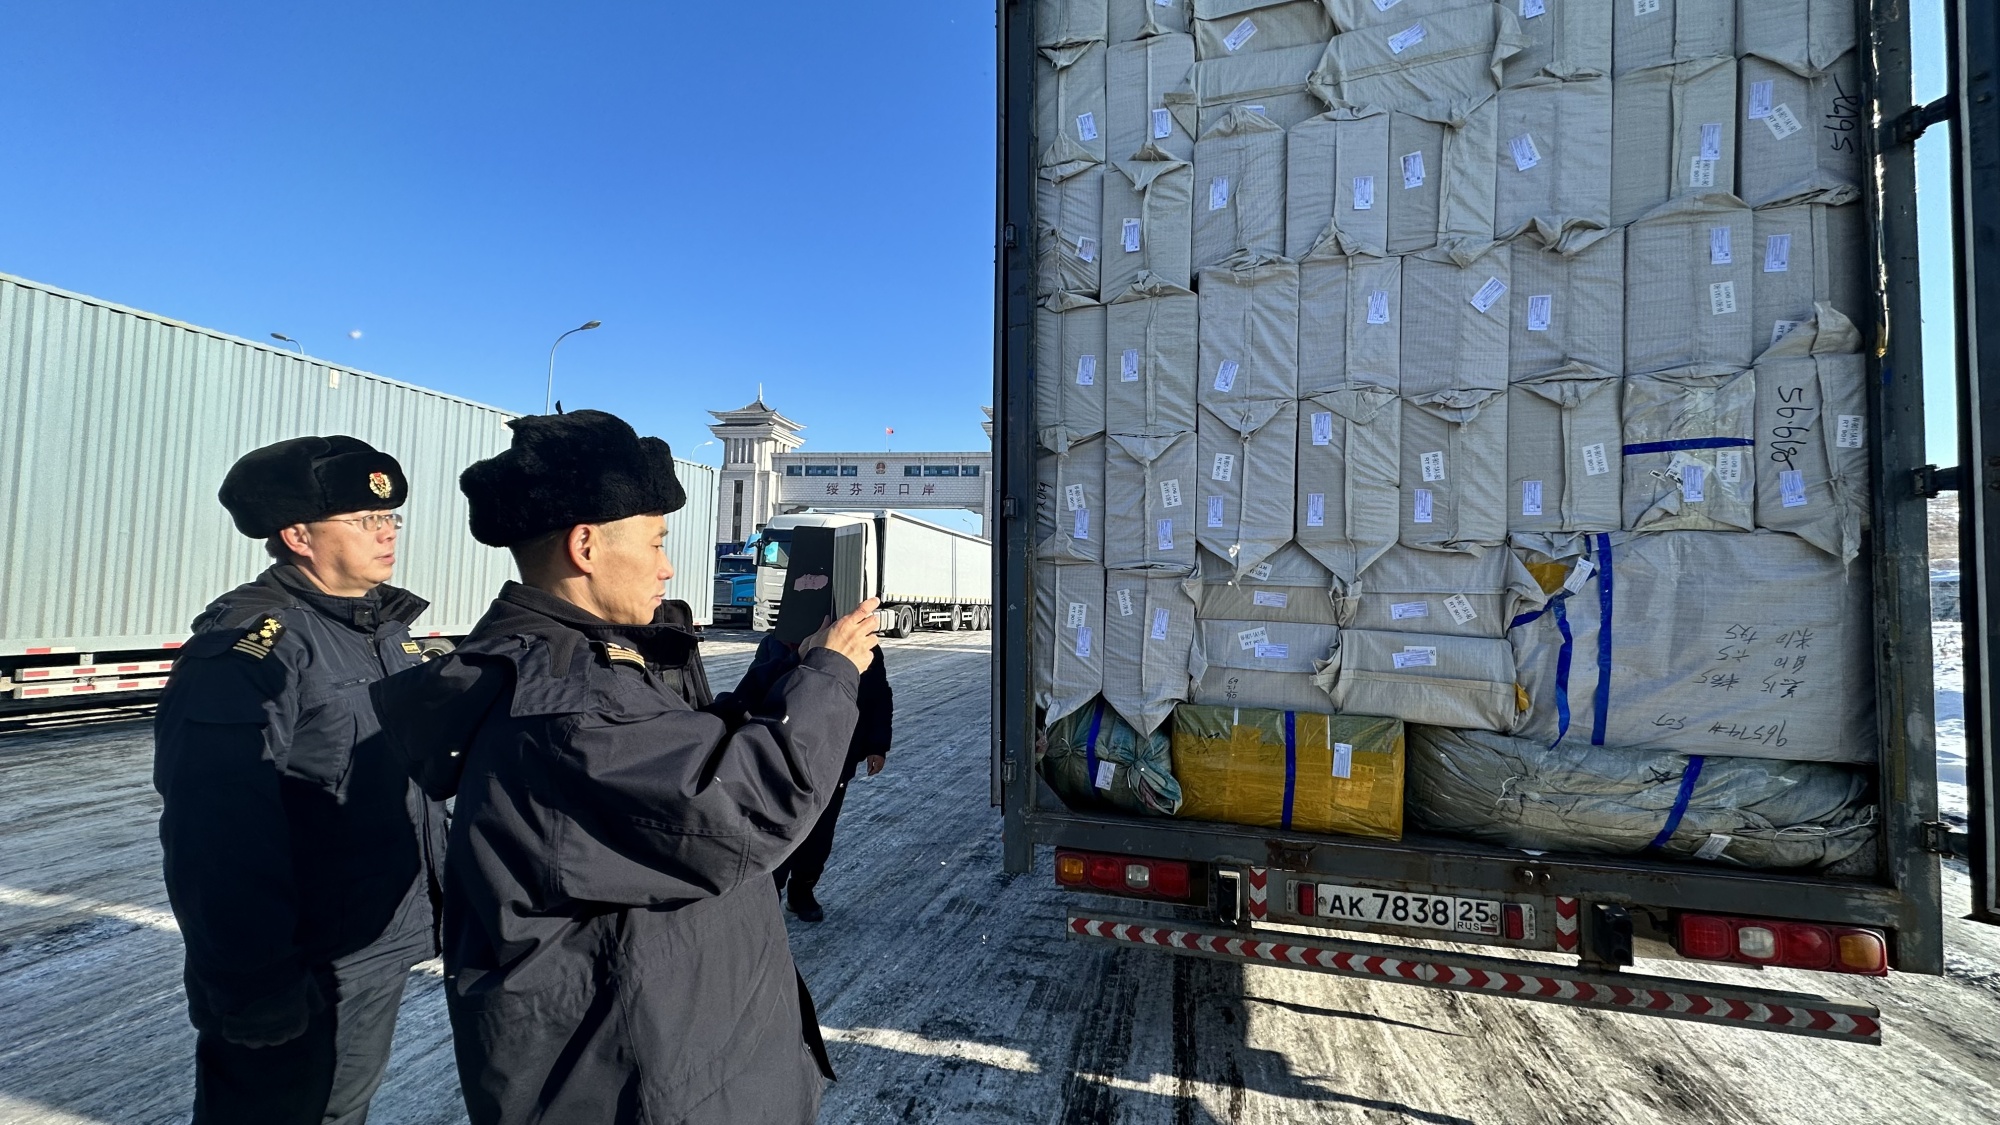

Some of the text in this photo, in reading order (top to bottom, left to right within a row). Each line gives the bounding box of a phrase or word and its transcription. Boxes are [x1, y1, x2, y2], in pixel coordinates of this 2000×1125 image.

[1700, 158, 1710, 186] -901-1A1-90
[826, 482, 935, 496] 绥芬河口岸
[1329, 893, 1489, 925] AK 7838 25
[1457, 921, 1480, 931] RUS
